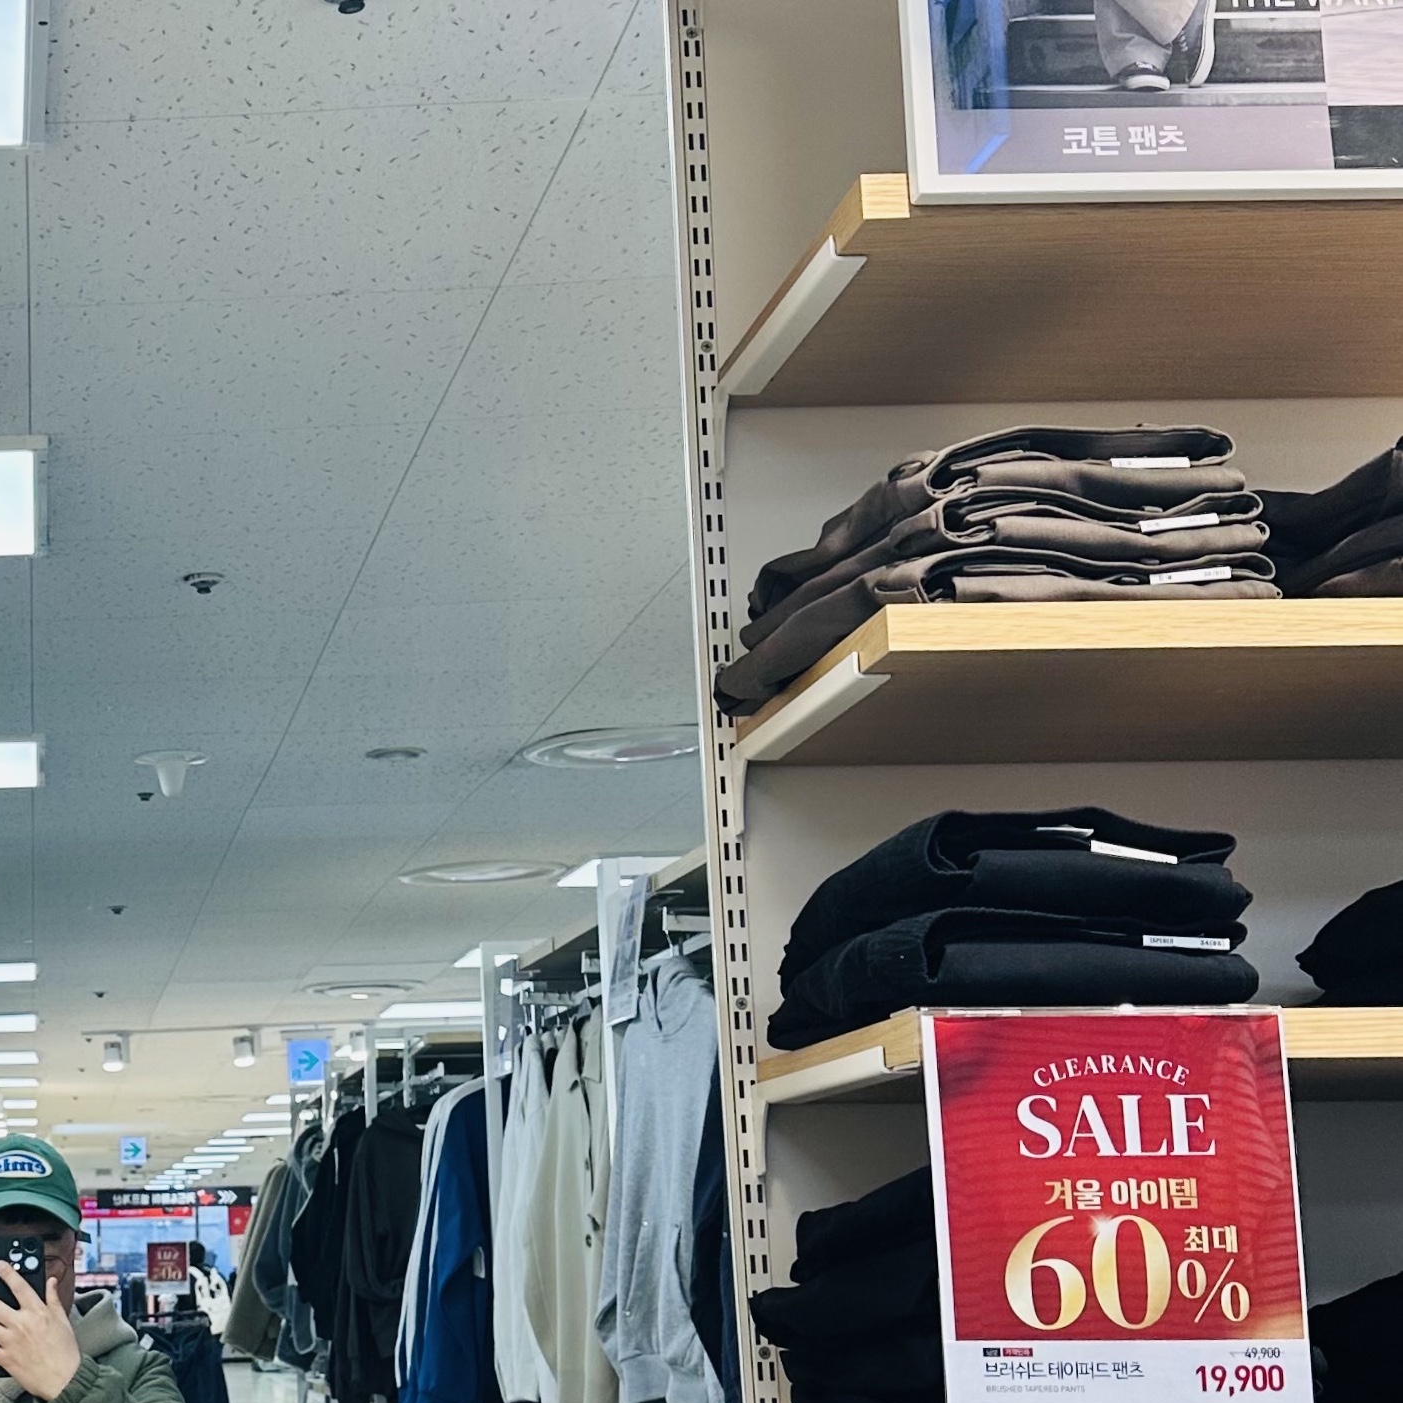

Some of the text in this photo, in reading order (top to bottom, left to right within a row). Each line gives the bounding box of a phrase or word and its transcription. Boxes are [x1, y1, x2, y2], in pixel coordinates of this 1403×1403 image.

[1062, 124, 1188, 156] 코튼 팬츠
[1033, 1054, 1190, 1088] CLEARANCE
[1016, 1094, 1216, 1159] SALE
[1044, 1177, 1199, 1210] 겨울 아이템
[1183, 1225, 1239, 1254] 최대
[1004, 1214, 1250, 1331] 60%
[1245, 1347, 1281, 1360] 49,900
[984, 1361, 1145, 1380] 브러쉬드 테이퍼드 팬츠
[1195, 1365, 1285, 1397] 19,900
[985, 1385, 1086, 1393] BRUSHED TAPERED PANTS
